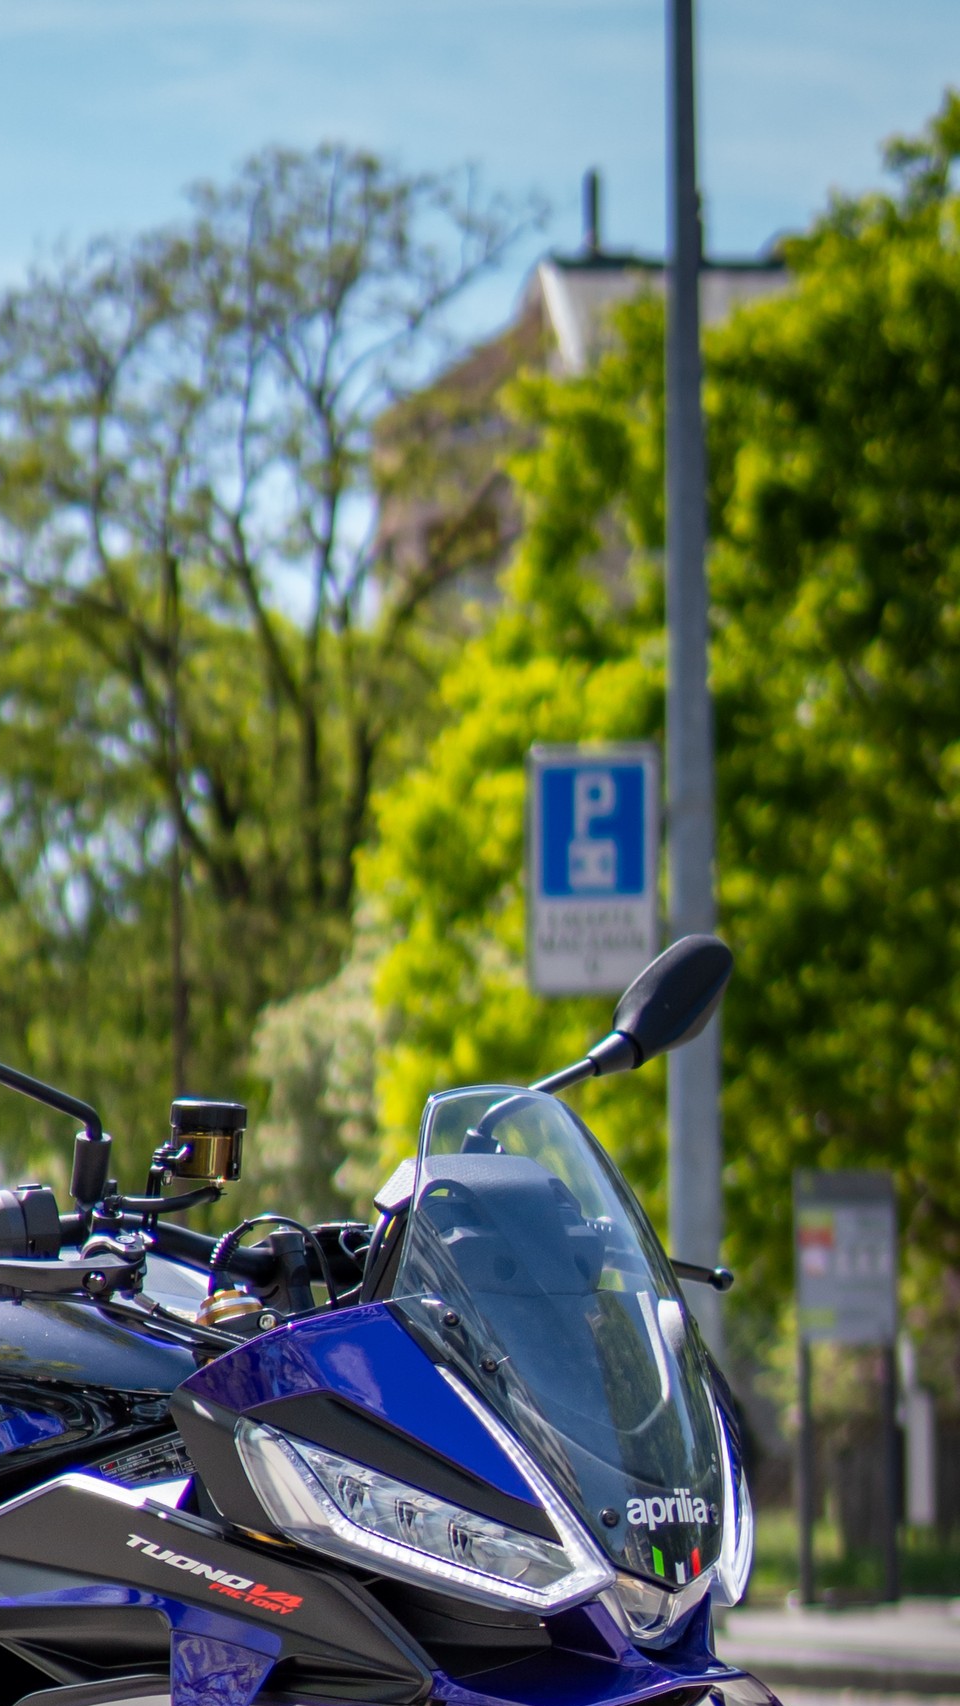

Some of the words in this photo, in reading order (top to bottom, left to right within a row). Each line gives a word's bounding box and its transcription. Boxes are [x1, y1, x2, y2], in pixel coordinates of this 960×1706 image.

[574, 771, 617, 839] P
[626, 1488, 708, 1531] aprilia
[126, 1533, 255, 1590] TUONO
[247, 1583, 304, 1610] V4
[208, 1583, 296, 1615] FACTORY
